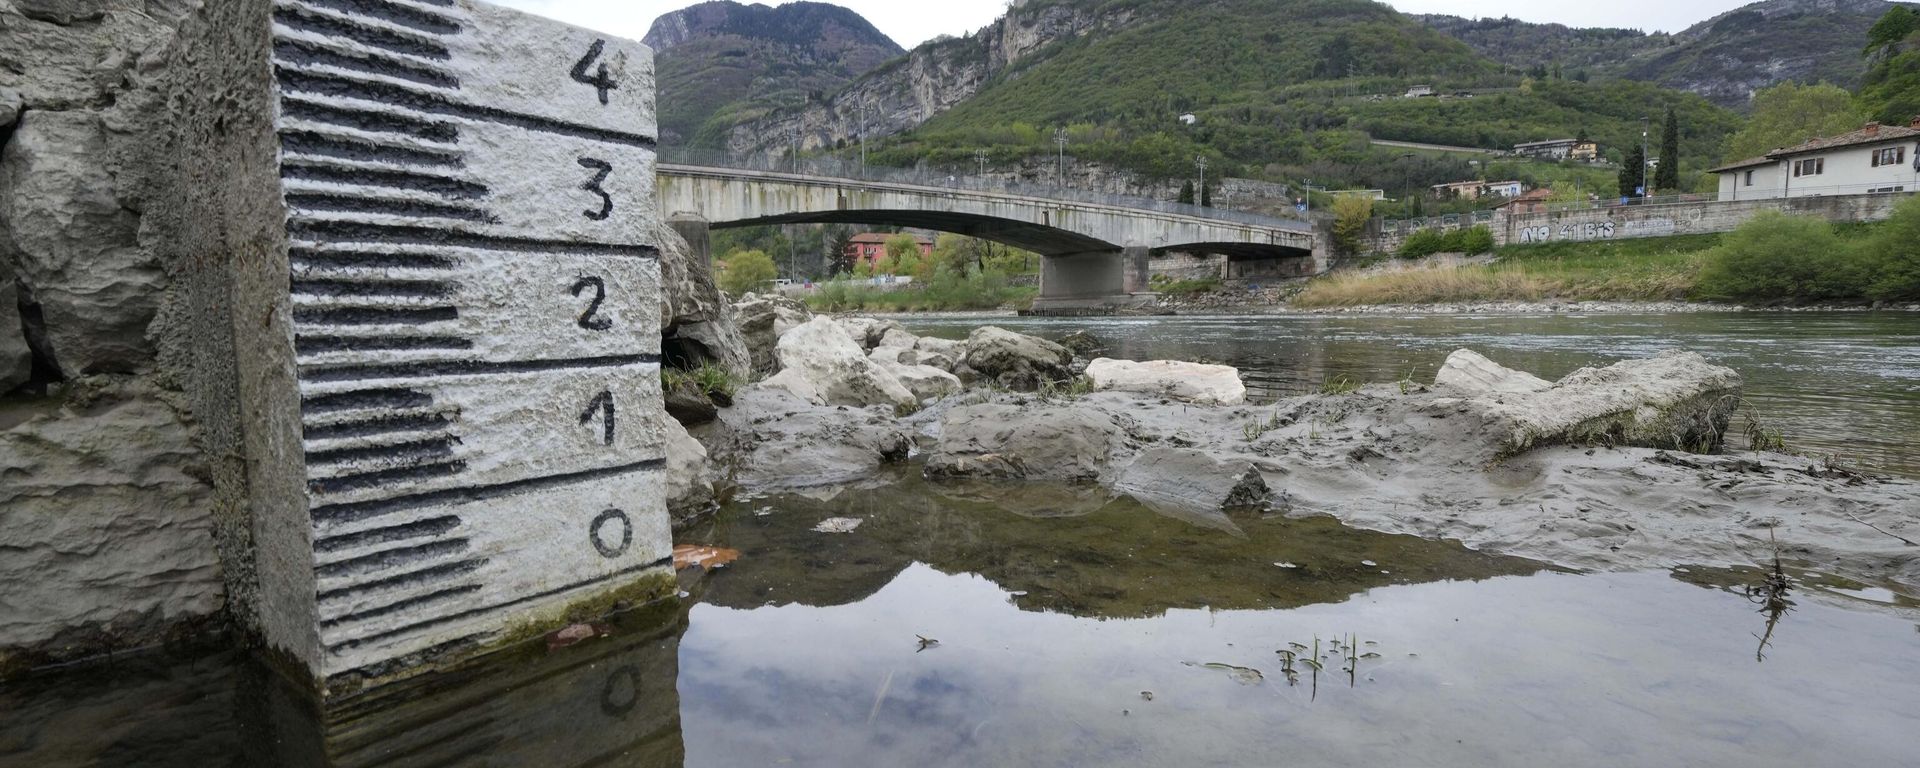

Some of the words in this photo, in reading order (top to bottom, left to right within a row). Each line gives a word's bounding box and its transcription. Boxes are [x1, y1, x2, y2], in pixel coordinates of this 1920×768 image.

[570, 38, 621, 104] 4
[577, 156, 614, 221] 3
[1519, 226, 1550, 243] NO
[1559, 224, 1579, 240] 41
[572, 273, 613, 330] 2
[579, 390, 615, 446] 1
[589, 508, 633, 558] 0
